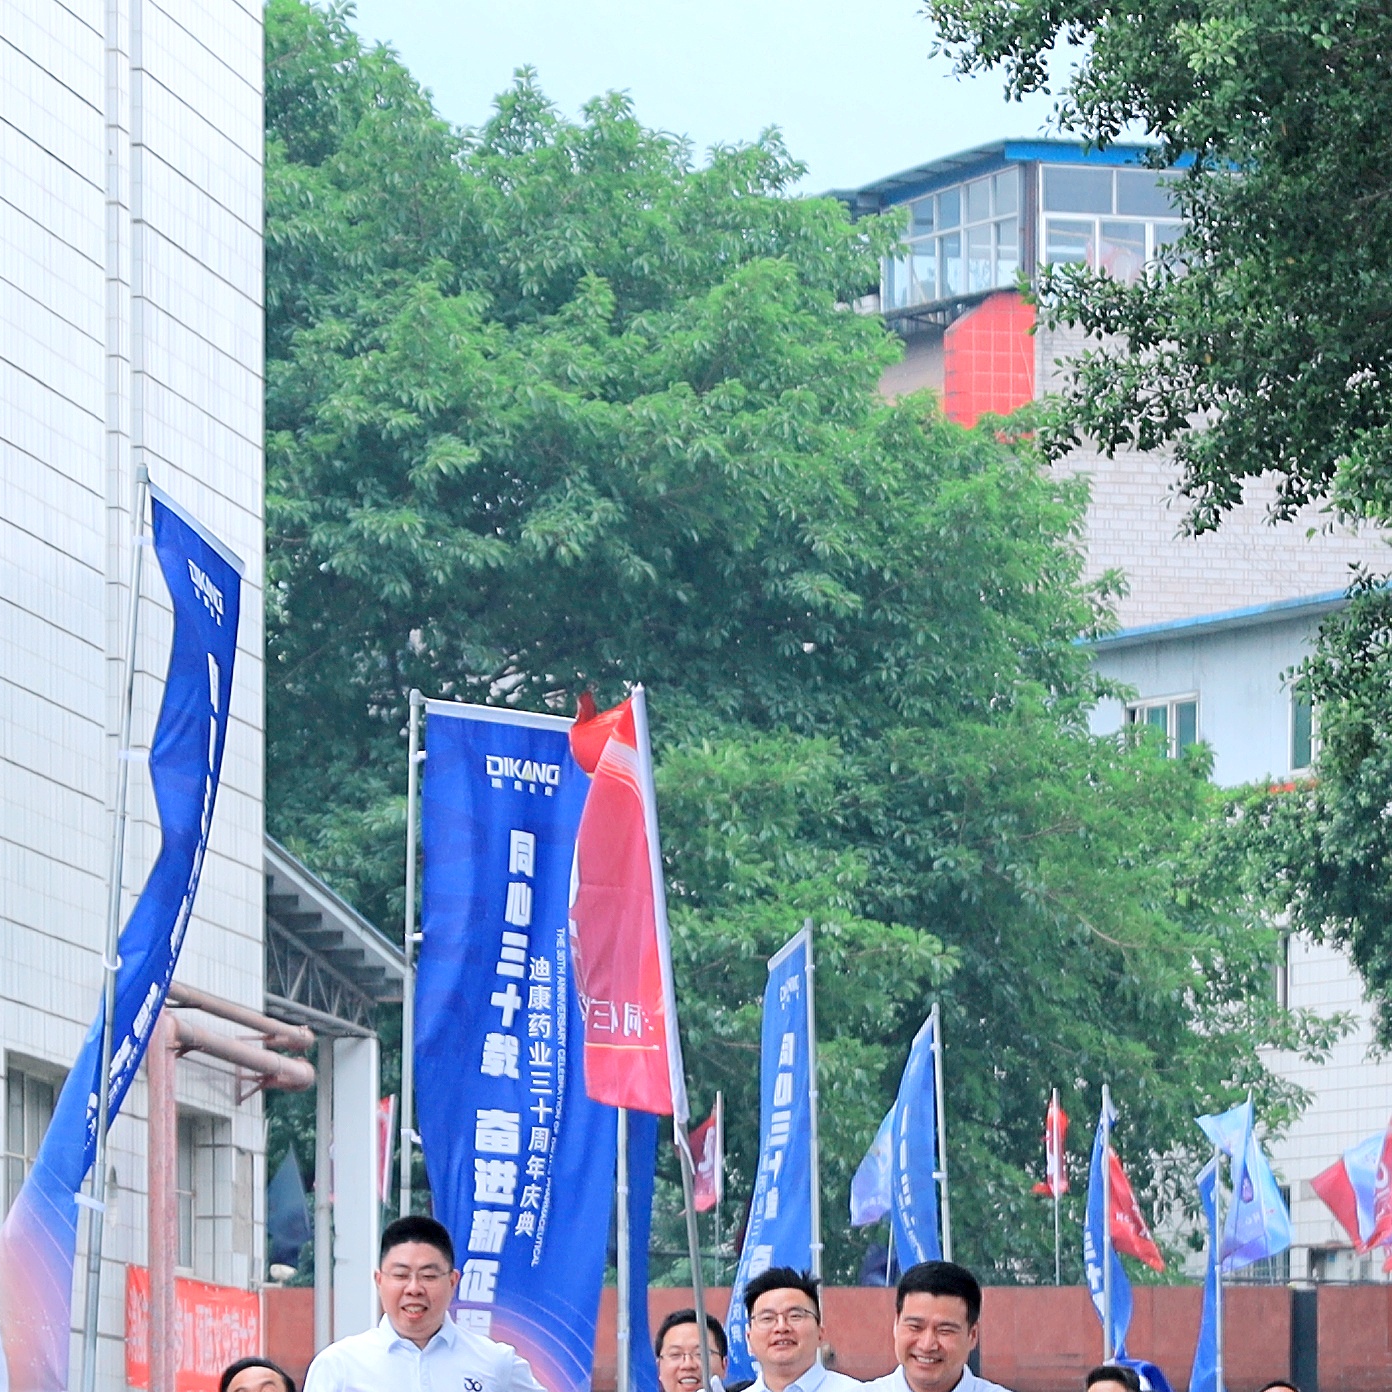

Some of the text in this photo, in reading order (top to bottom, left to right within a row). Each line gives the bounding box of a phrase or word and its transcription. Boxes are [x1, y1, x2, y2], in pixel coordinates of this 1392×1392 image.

[485, 754, 561, 786] DIKANG
[515, 955, 554, 1238] 迪康药业三十周年庆典
